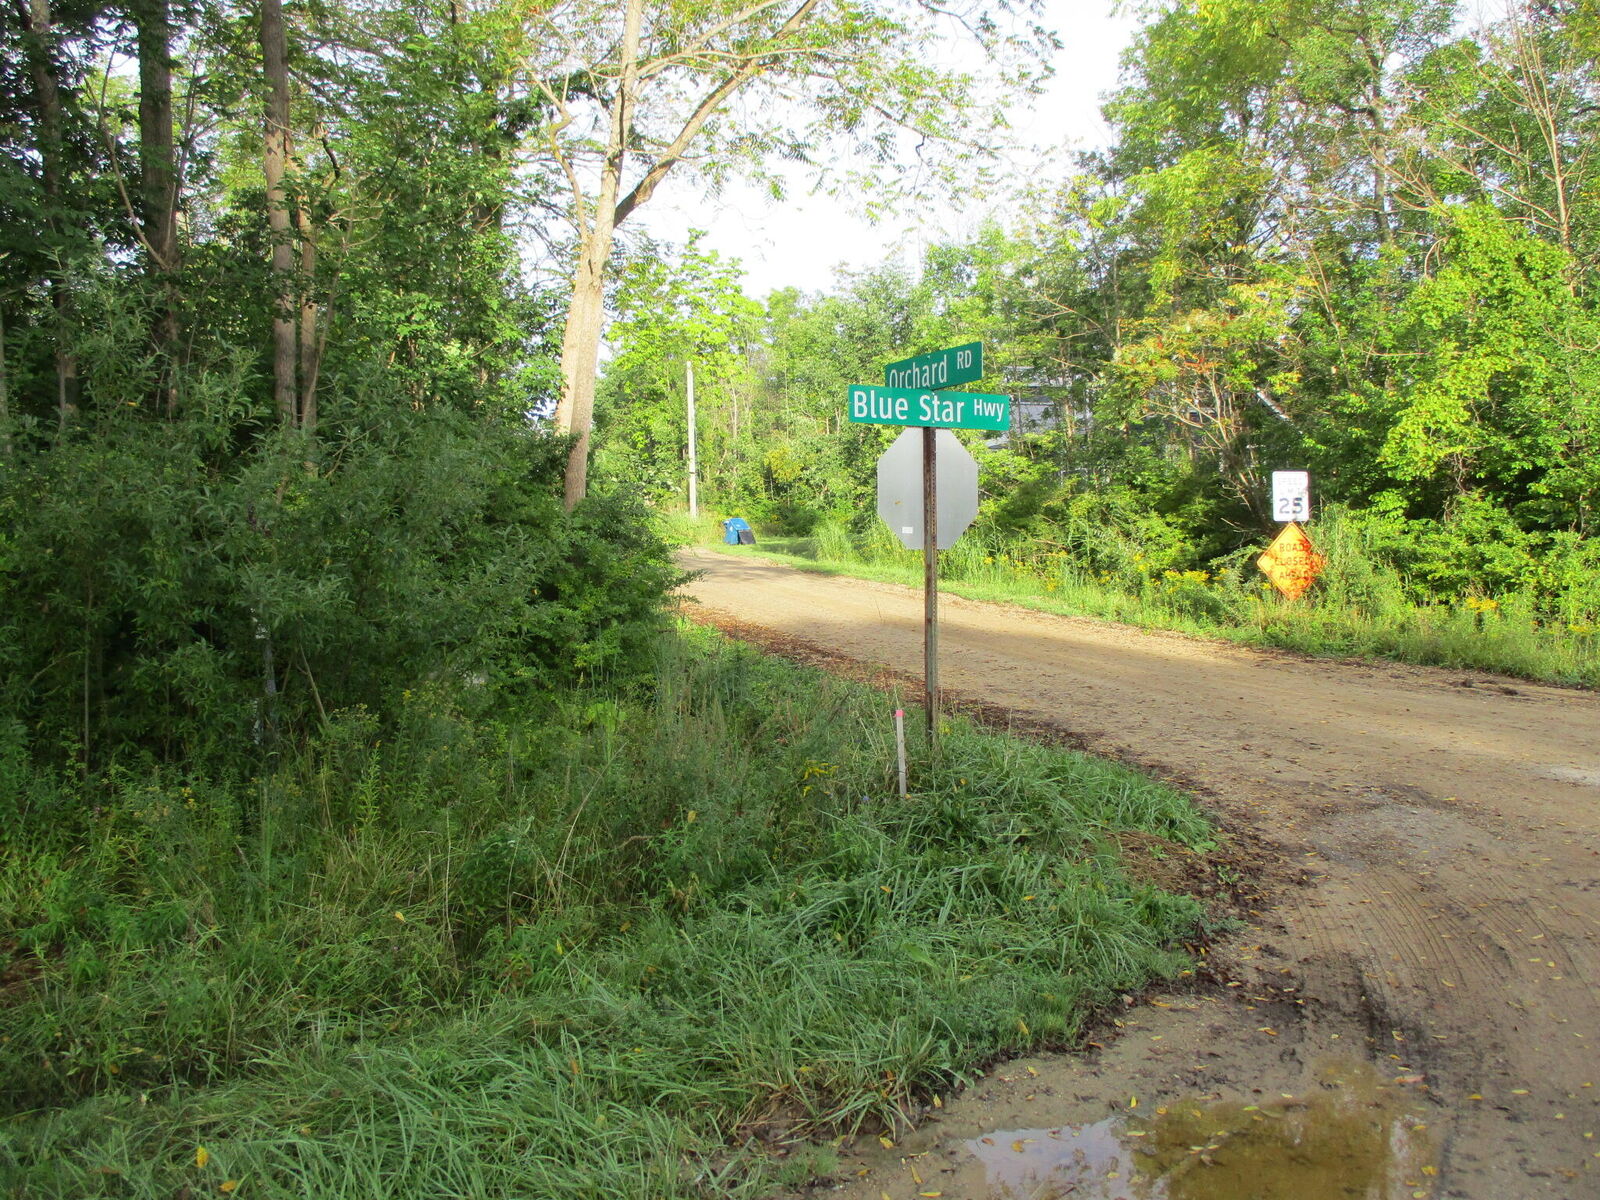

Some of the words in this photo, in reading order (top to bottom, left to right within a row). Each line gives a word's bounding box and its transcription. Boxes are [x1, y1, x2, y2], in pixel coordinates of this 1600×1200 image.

[889, 354, 947, 389] Orchard
[957, 350, 972, 370] RD
[853, 390, 909, 420] Blue
[919, 393, 965, 423] Star
[973, 398, 1005, 422] Hwy
[1279, 497, 1303, 514] 25
[1279, 543, 1304, 552] ROAD
[1274, 556, 1311, 566] CLOSED
